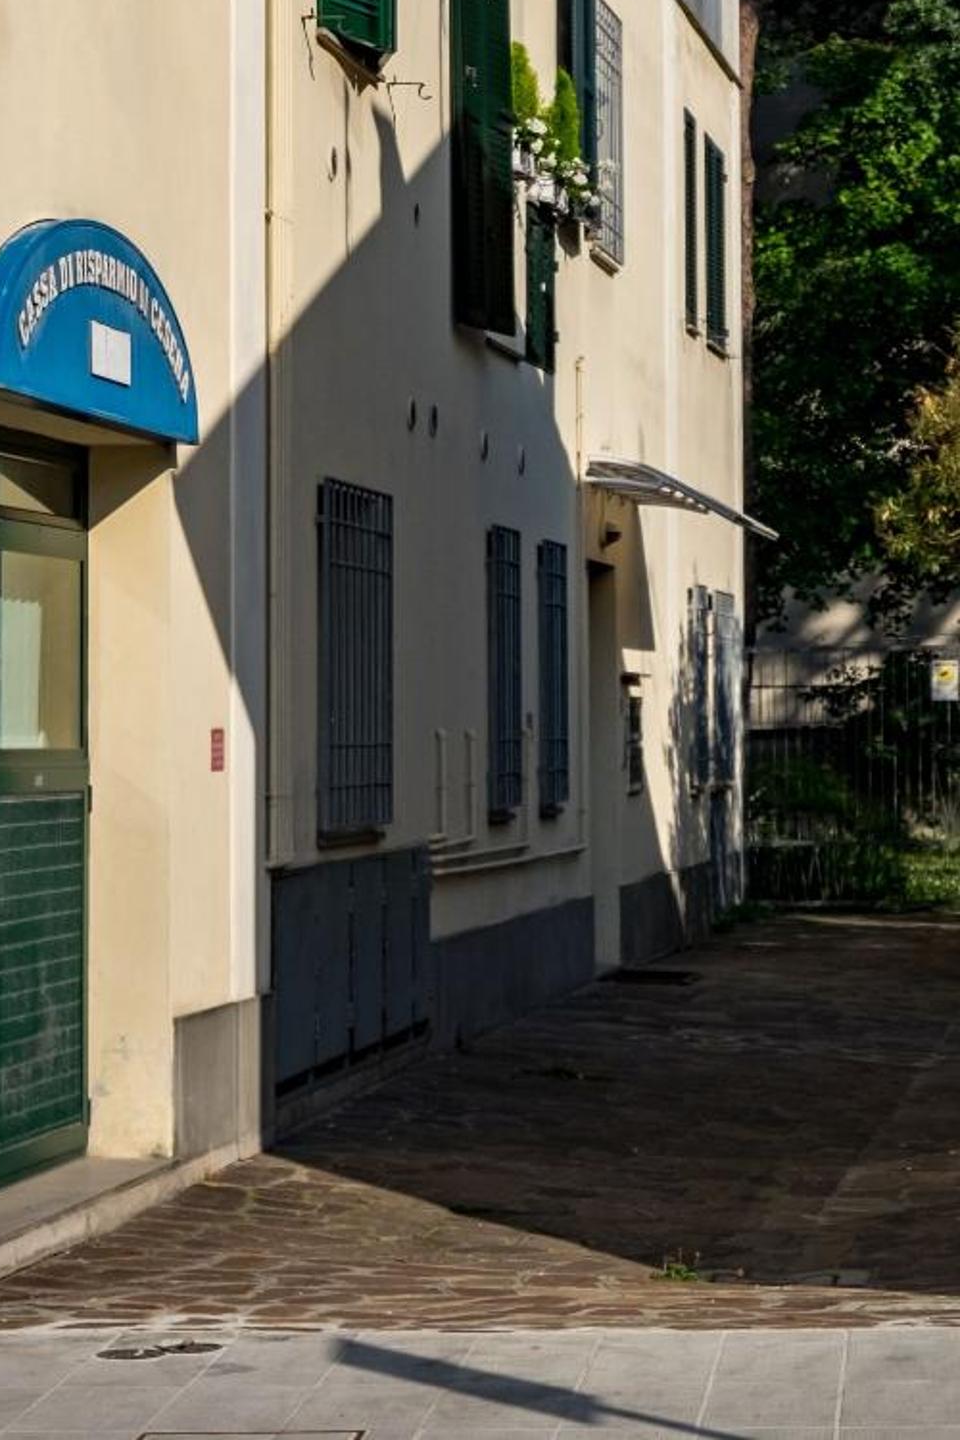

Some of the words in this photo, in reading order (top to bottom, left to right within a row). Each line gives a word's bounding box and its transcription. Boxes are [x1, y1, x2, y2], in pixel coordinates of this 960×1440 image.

[18, 264, 59, 347] CASSA
[59, 255, 73, 291] DI
[76, 249, 137, 301] RISPARMIO
[151, 297, 189, 404] CESENA
